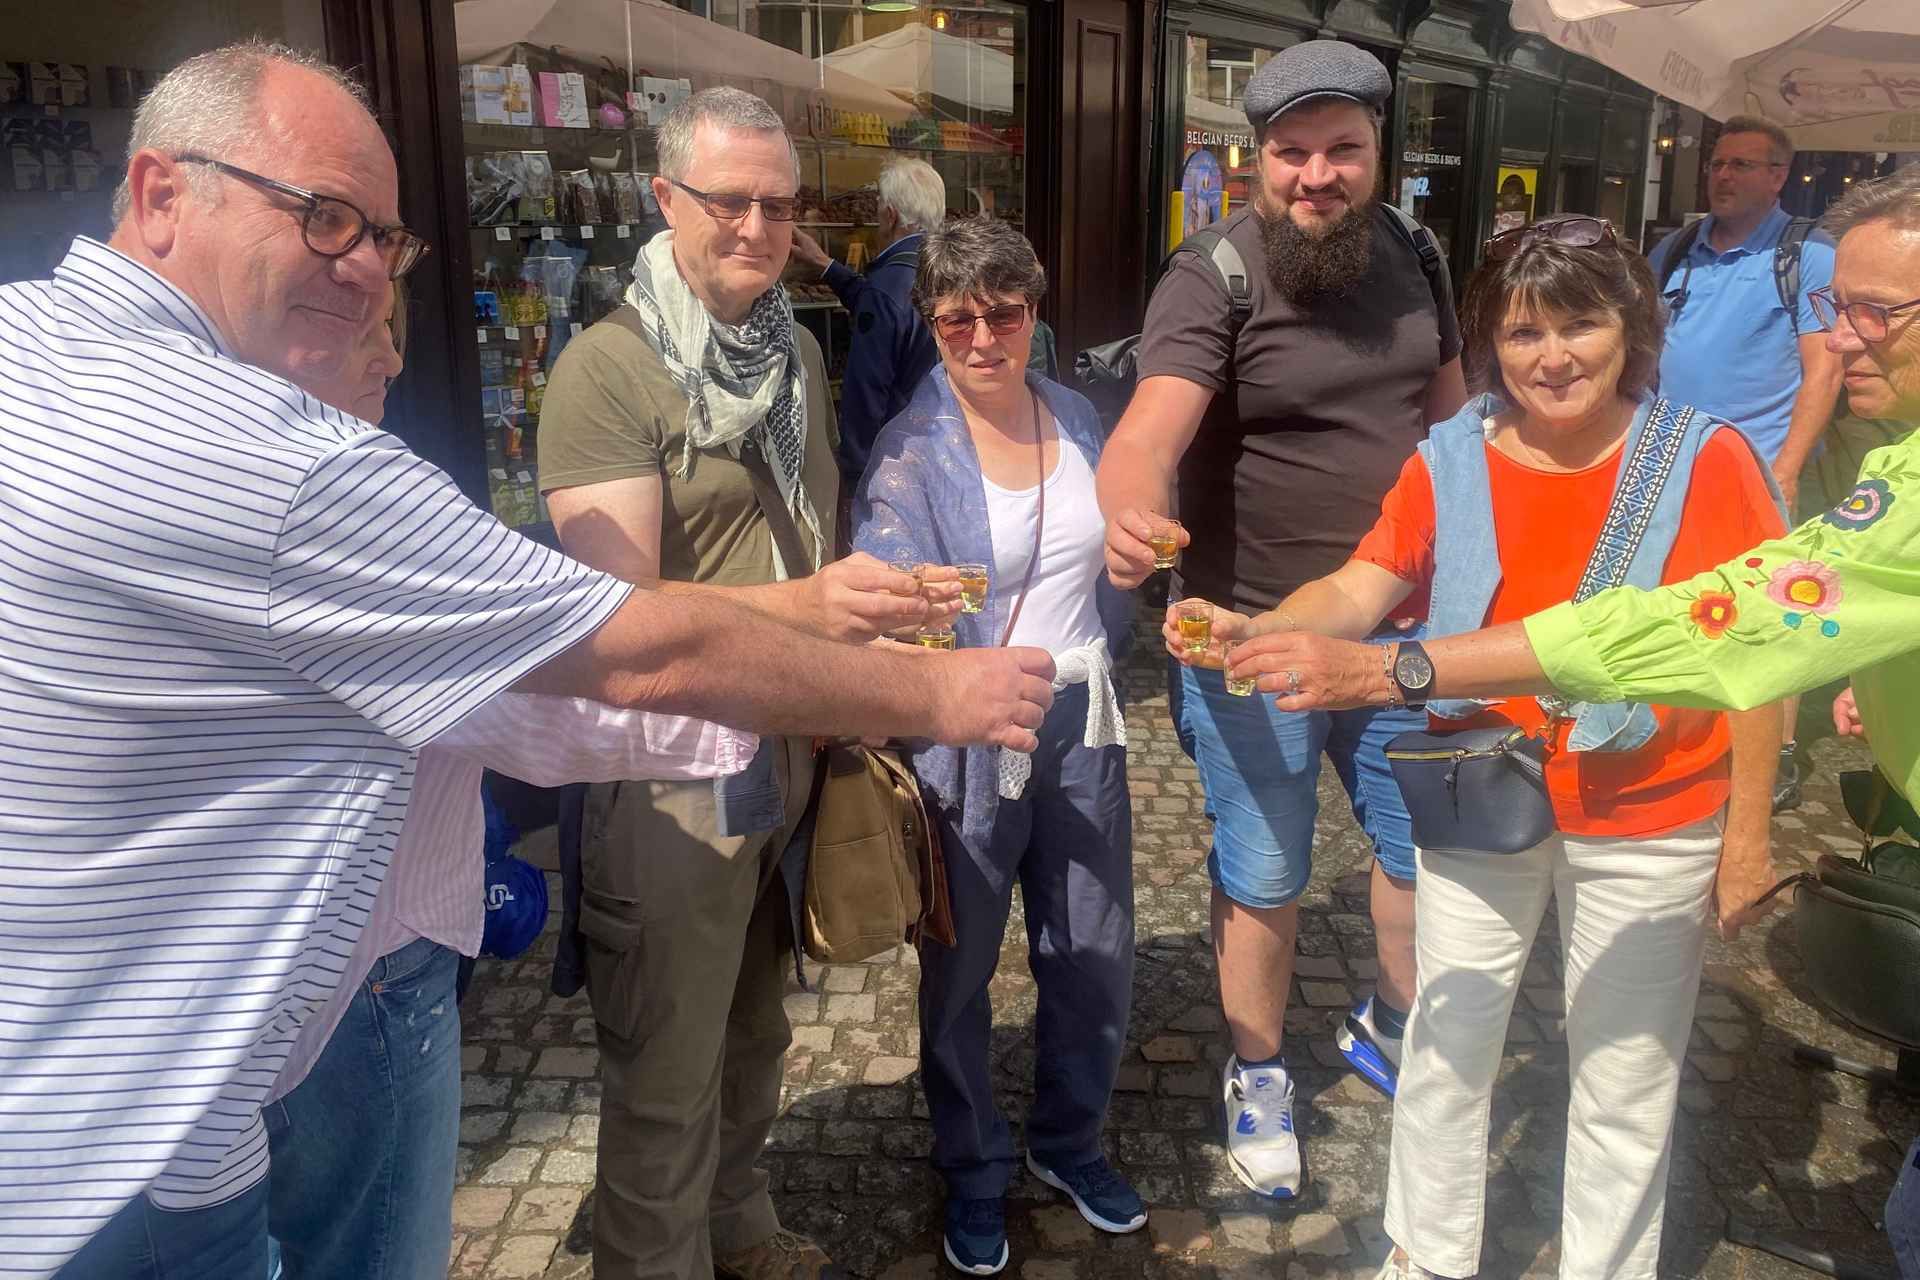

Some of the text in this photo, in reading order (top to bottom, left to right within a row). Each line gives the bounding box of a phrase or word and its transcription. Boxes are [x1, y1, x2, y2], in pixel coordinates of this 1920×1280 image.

[1187, 130, 1222, 145] BELGIAN
[1223, 133, 1248, 148] BEERS
[1403, 151, 1424, 162] BELGIAN
